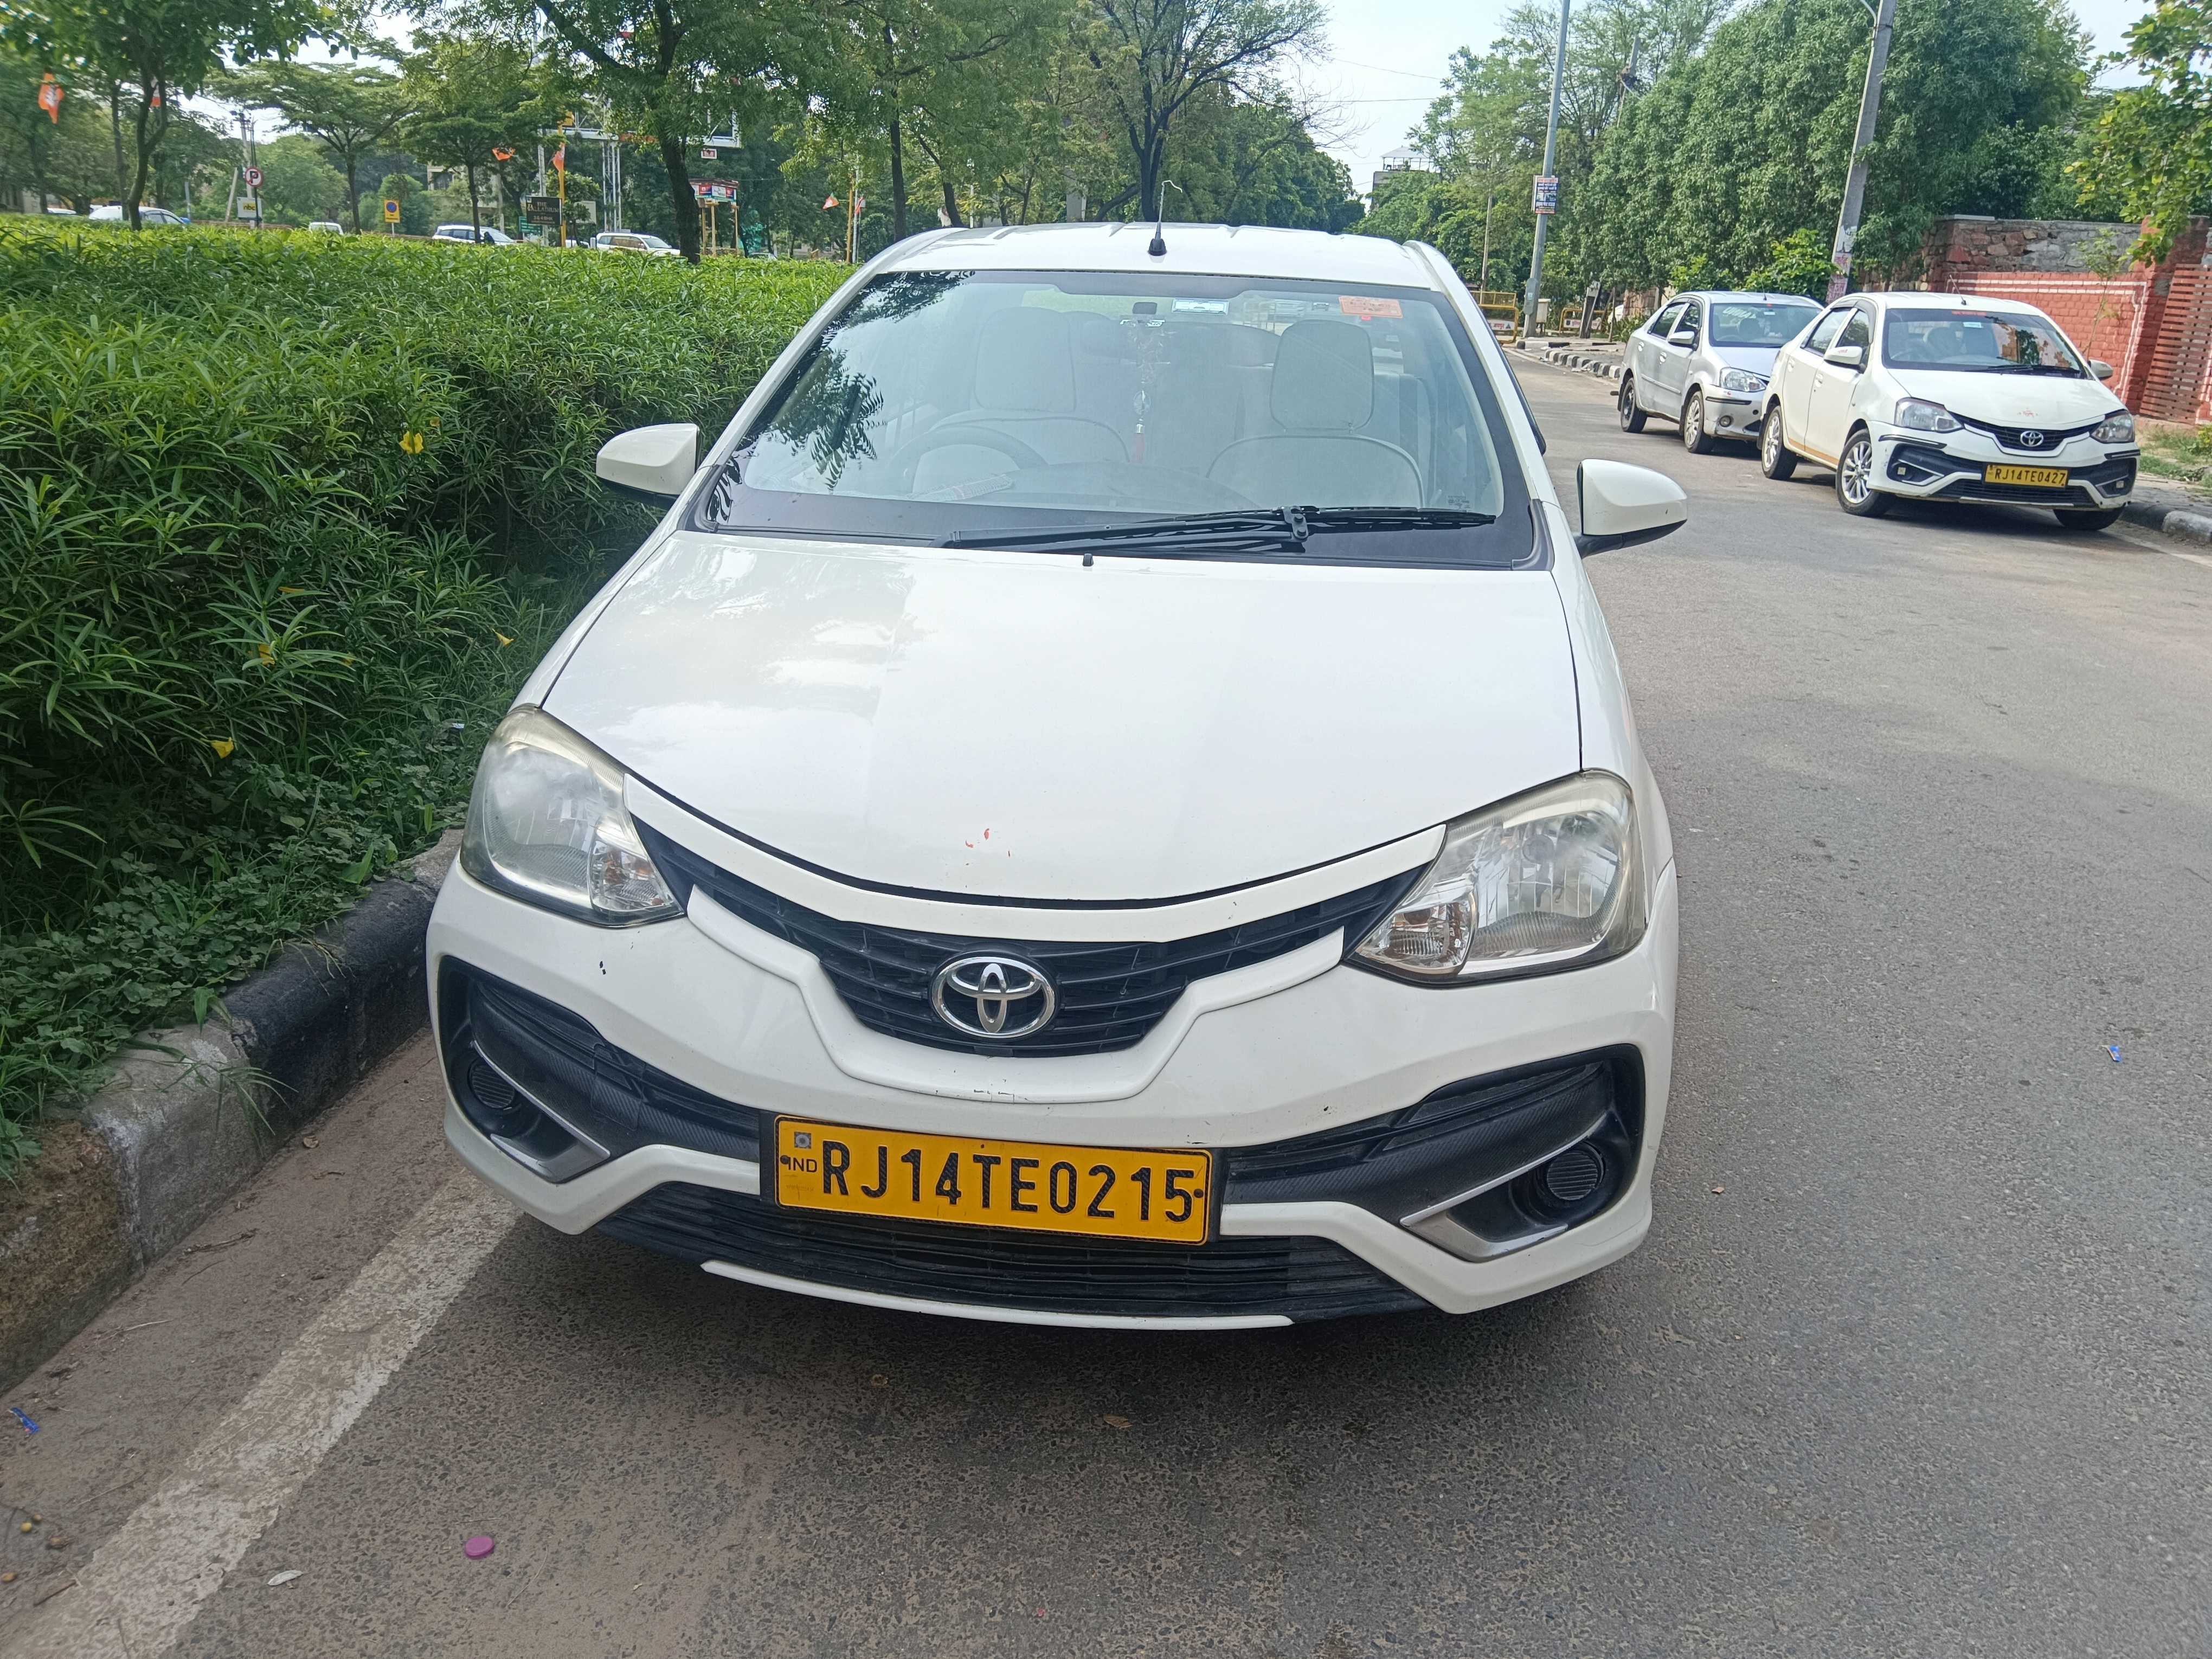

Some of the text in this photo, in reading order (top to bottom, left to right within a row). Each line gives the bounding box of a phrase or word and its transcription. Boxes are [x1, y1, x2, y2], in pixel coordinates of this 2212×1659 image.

[1995, 468, 2066, 484] RJ14TE0427
[788, 1156, 818, 1173] IND
[822, 1140, 1194, 1223] RJ14TE0215
